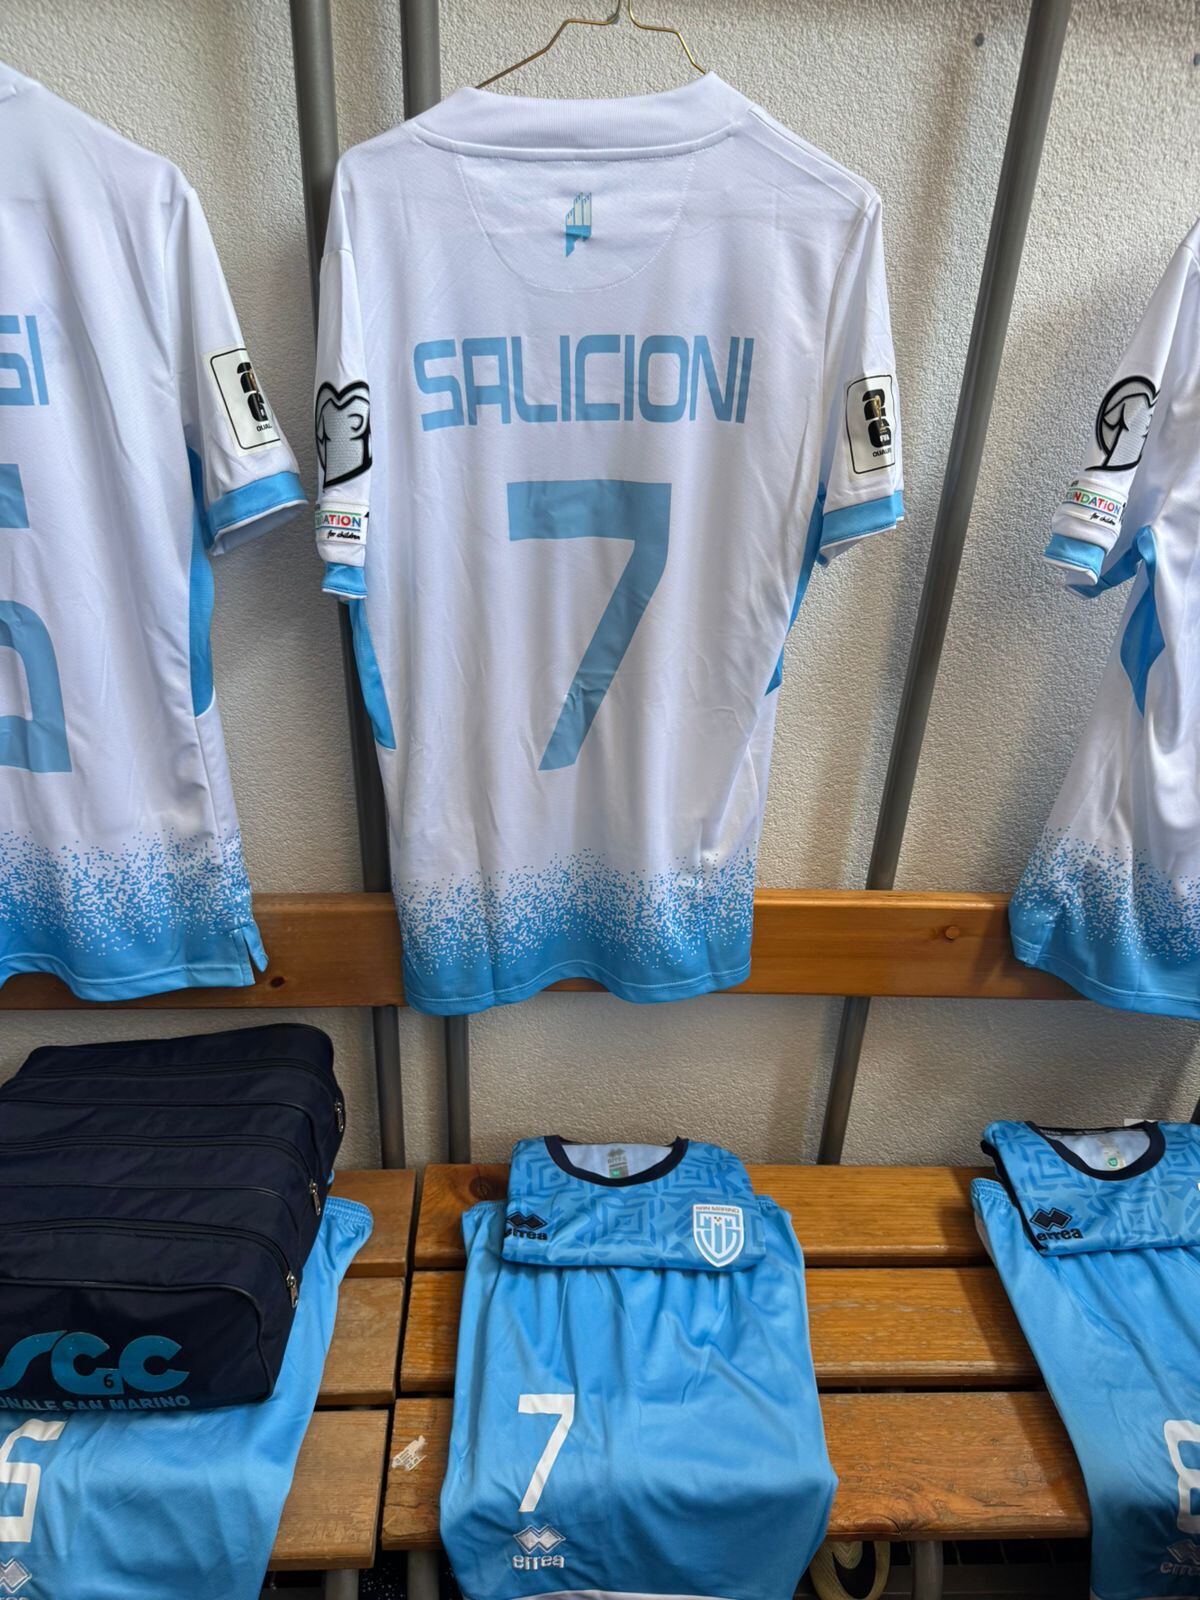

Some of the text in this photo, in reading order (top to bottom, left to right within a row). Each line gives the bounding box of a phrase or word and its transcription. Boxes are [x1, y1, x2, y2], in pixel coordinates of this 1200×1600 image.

[413, 334, 755, 432] SALICIONI
[320, 514, 362, 528] ATION
[506, 478, 673, 772] 7
[1036, 1227, 1084, 1242] errea
[103, 1373, 115, 1389] 6
[62, 1398, 104, 1411] SAN
[109, 1394, 191, 1411] MARINO
[517, 1393, 576, 1513] 7
[512, 1554, 565, 1571] errea
